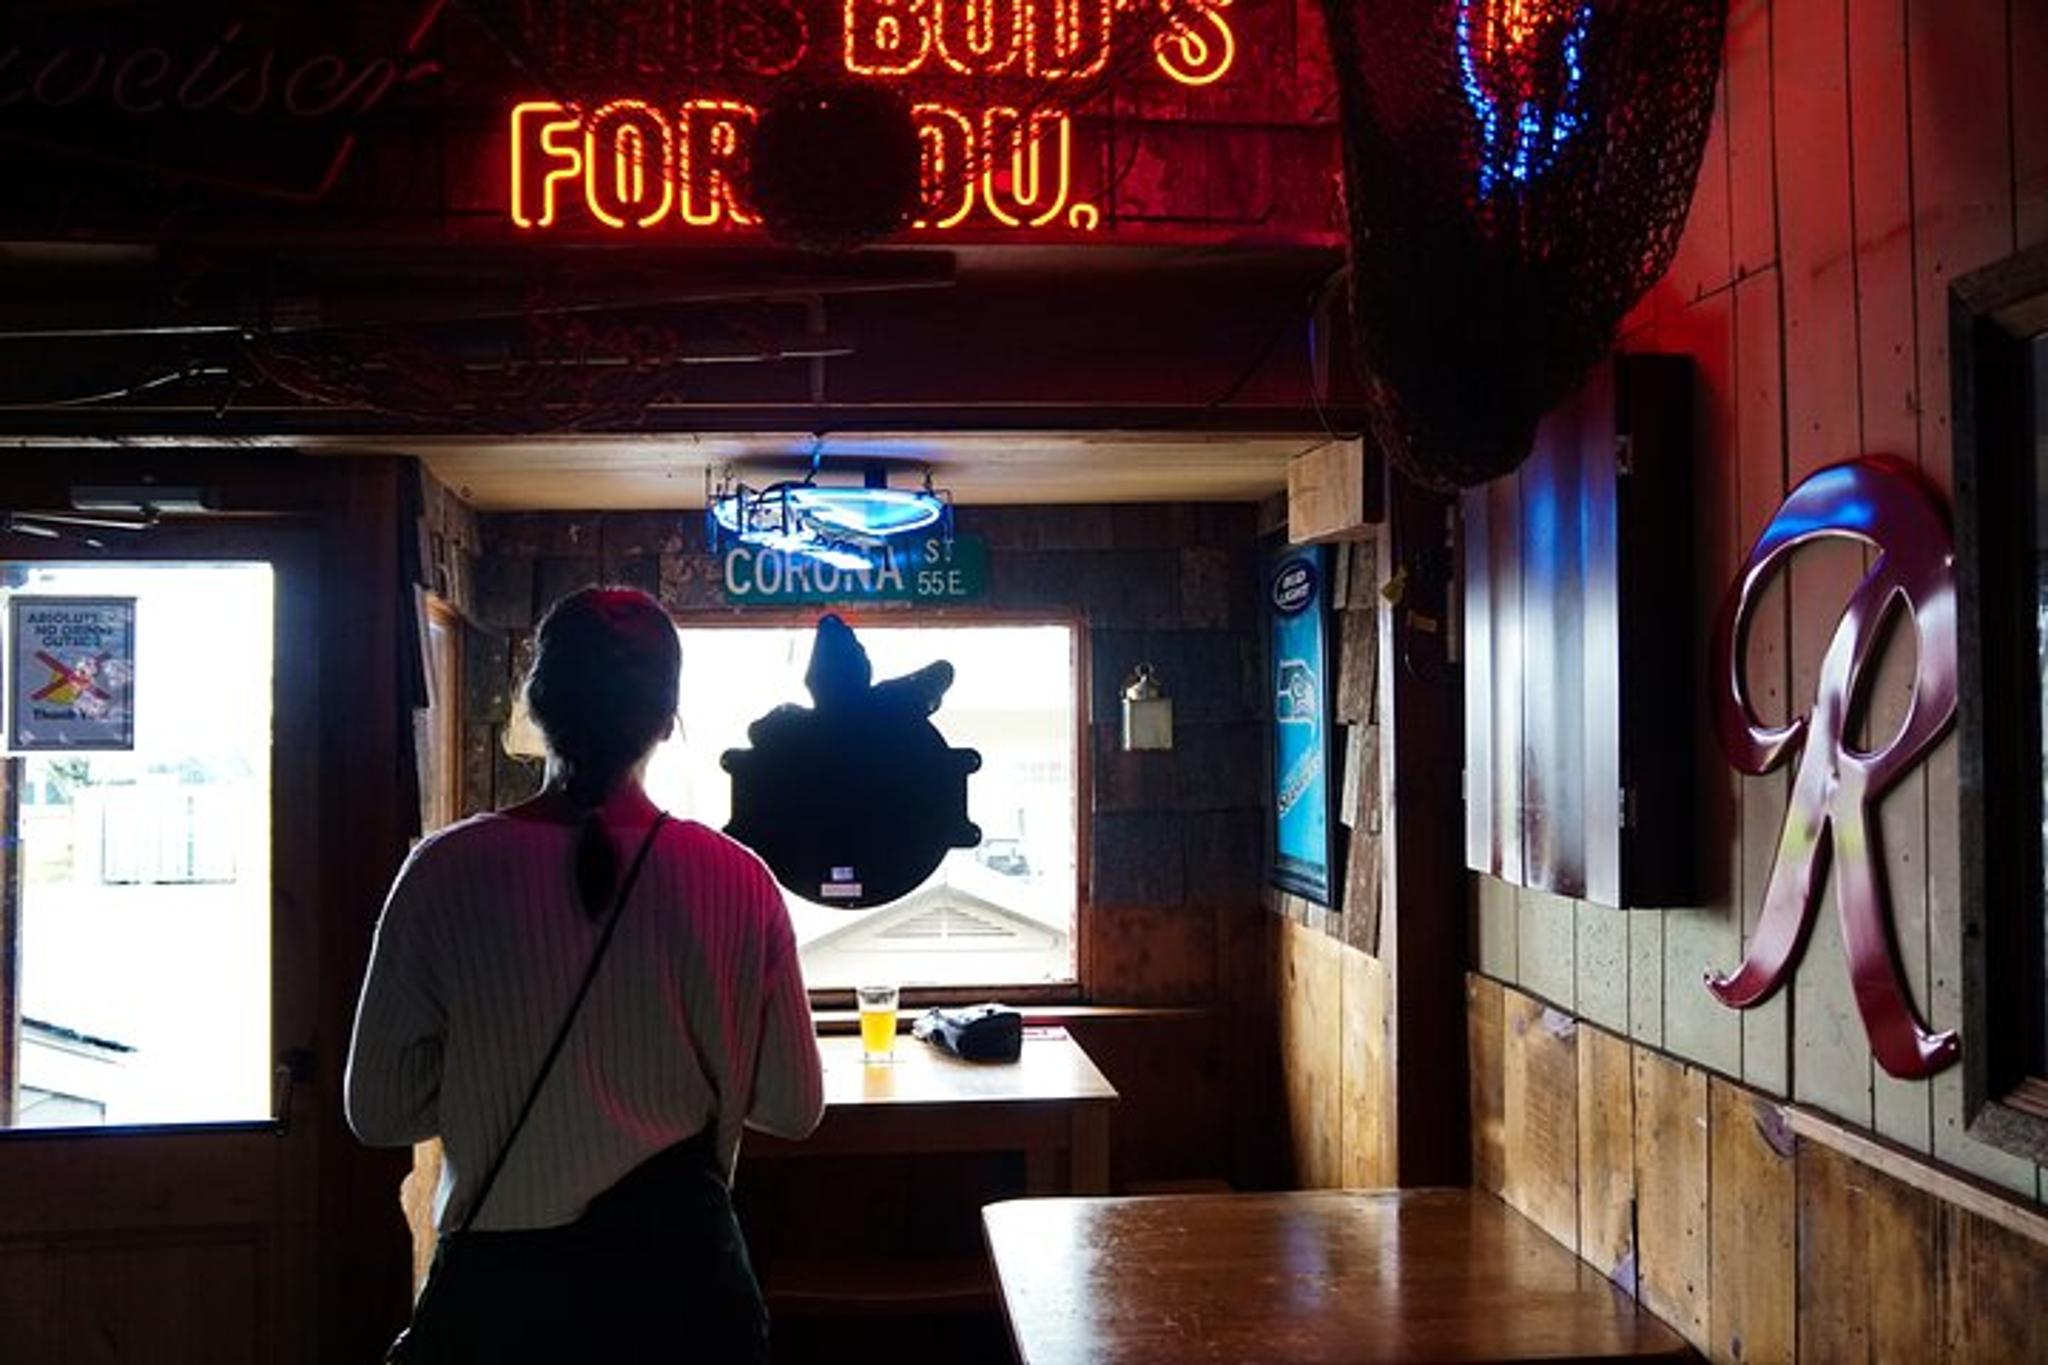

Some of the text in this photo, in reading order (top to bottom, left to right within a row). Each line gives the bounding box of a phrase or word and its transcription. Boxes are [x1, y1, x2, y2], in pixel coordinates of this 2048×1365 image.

[845, 0, 1235, 85] BUDS
[511, 99, 1099, 231] FOR OU.
[724, 538, 957, 595] CORONA ST
[916, 569, 967, 596] 55E
